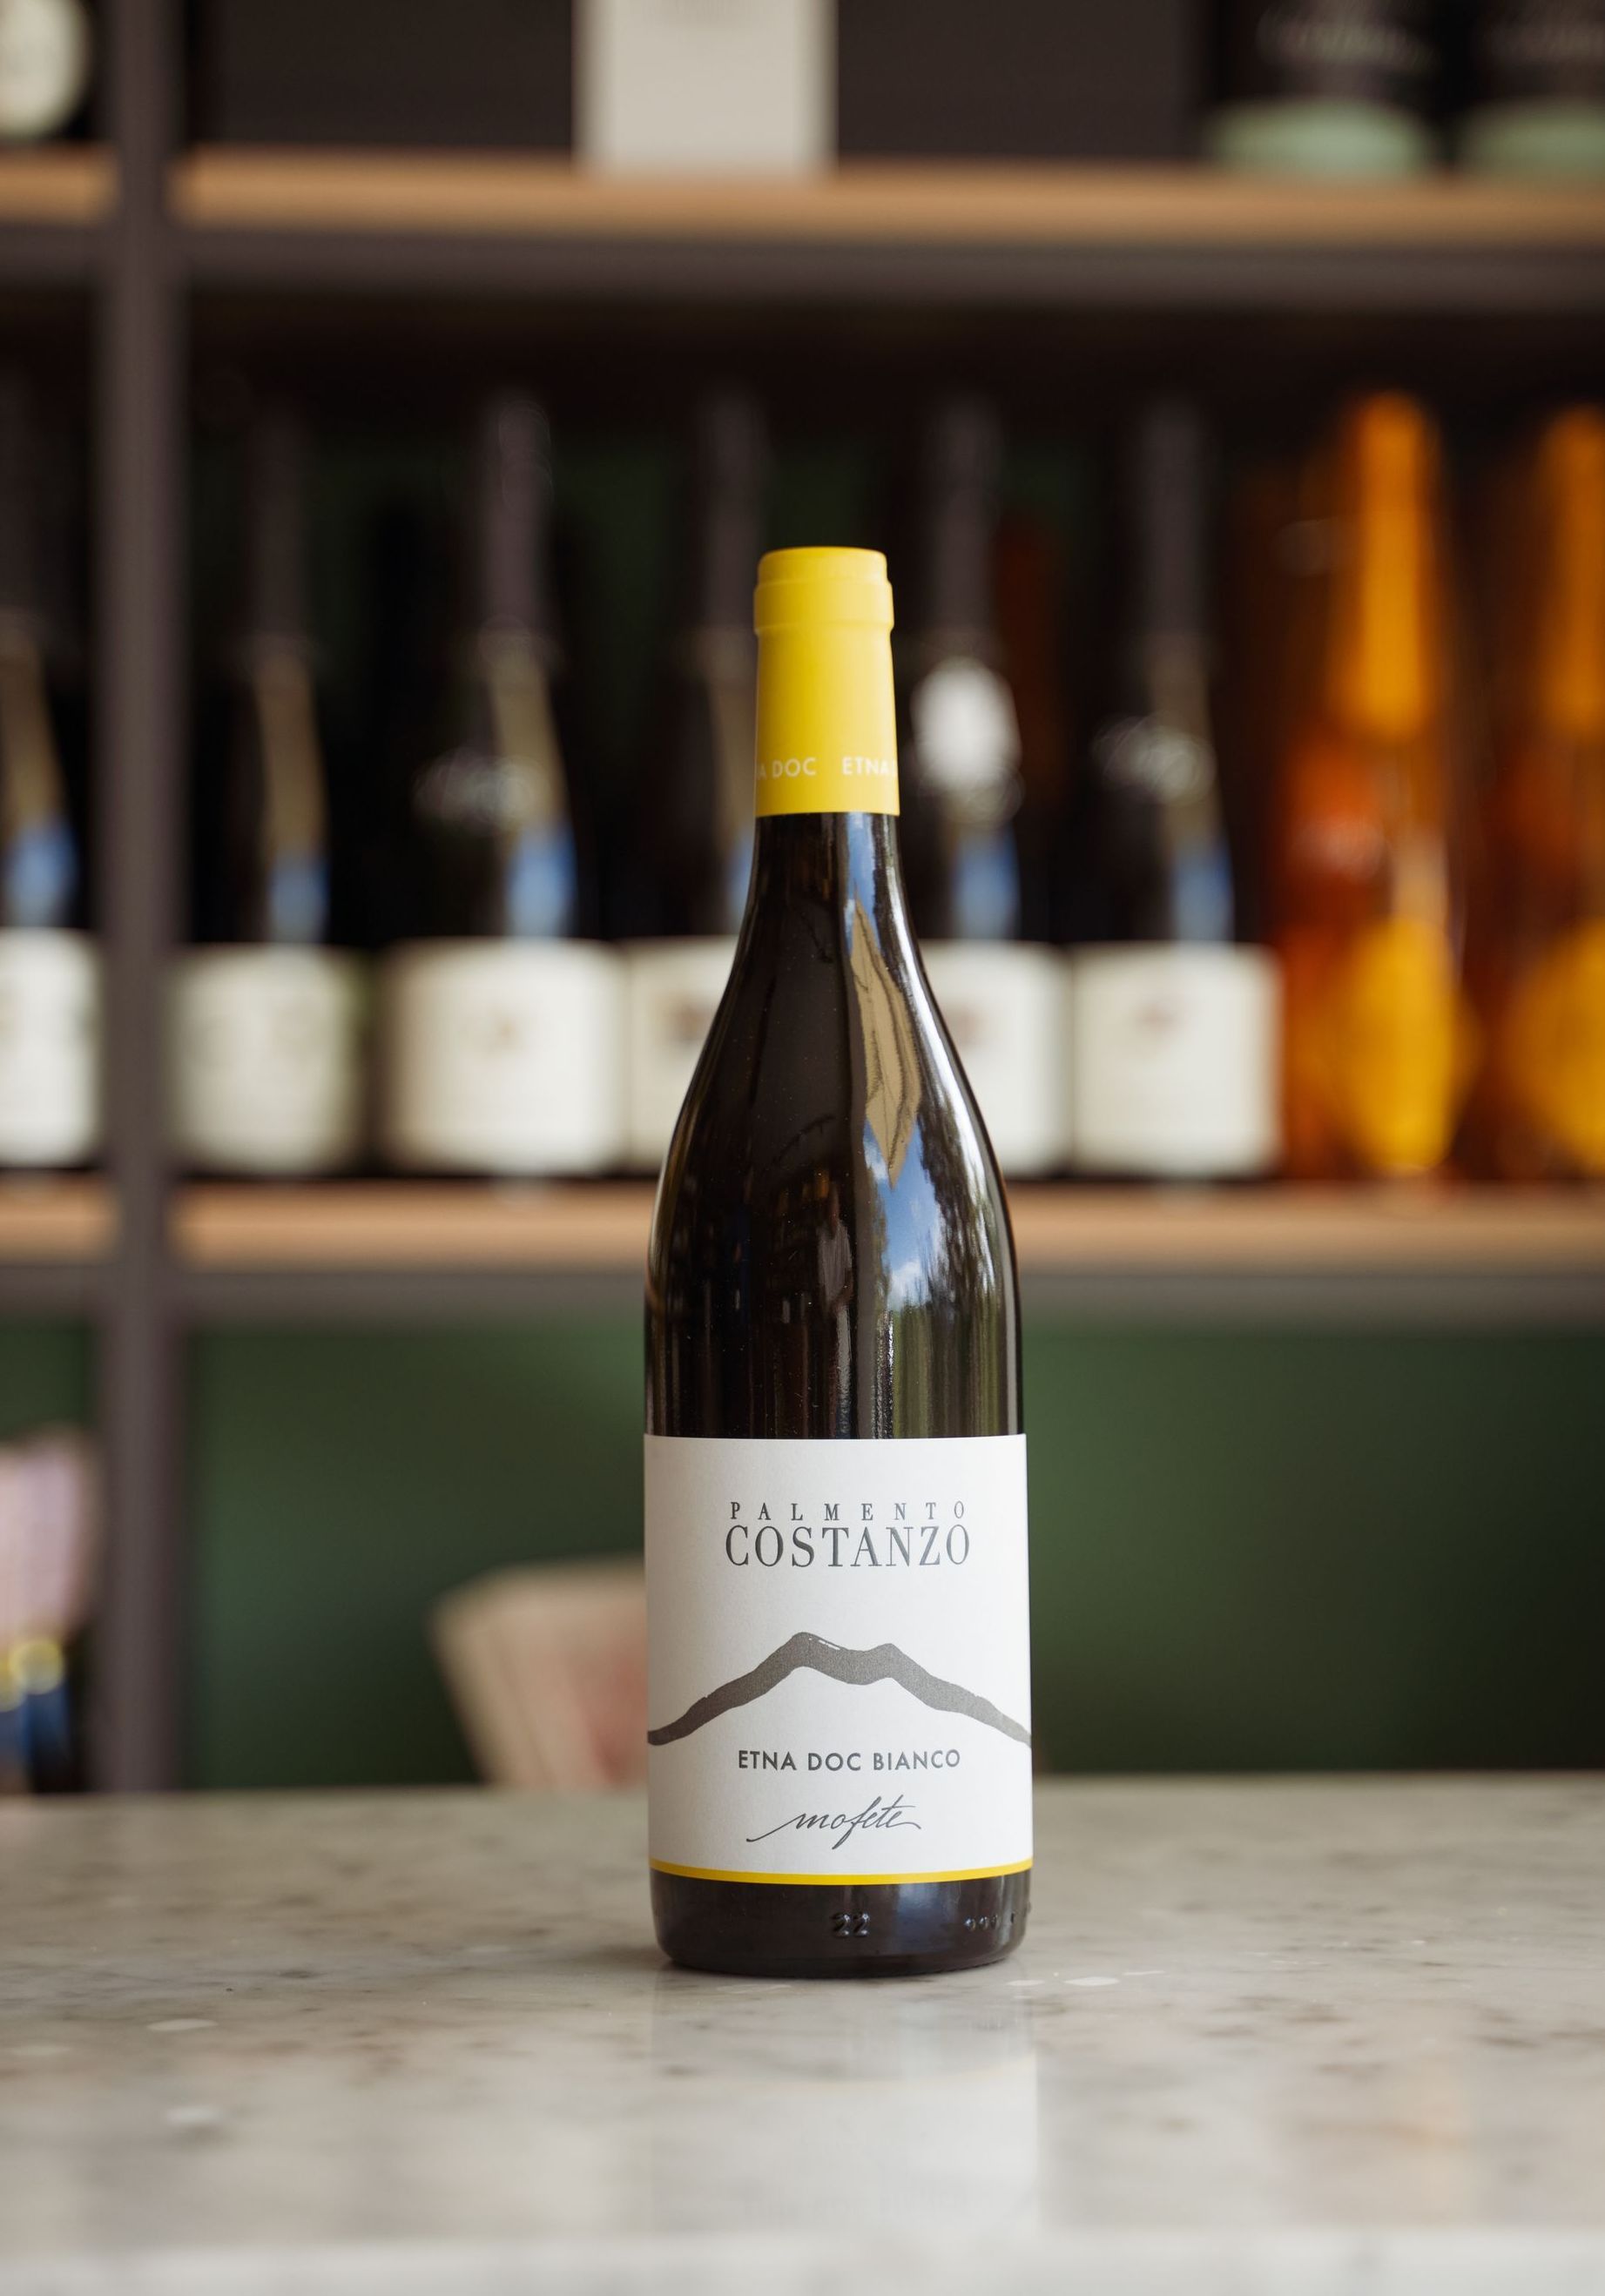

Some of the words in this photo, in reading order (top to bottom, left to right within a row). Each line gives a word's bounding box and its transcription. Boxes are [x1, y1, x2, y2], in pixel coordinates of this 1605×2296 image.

[772, 757, 817, 778] DOC
[842, 756, 891, 776] ETNA
[730, 1501, 965, 1521] PALMENTO
[725, 1524, 970, 1567] COSTANZO
[738, 1749, 796, 1771] ETNA
[807, 1752, 862, 1771] DOC
[873, 1749, 961, 1771] BIANCO
[746, 1794, 921, 1850] mofete
